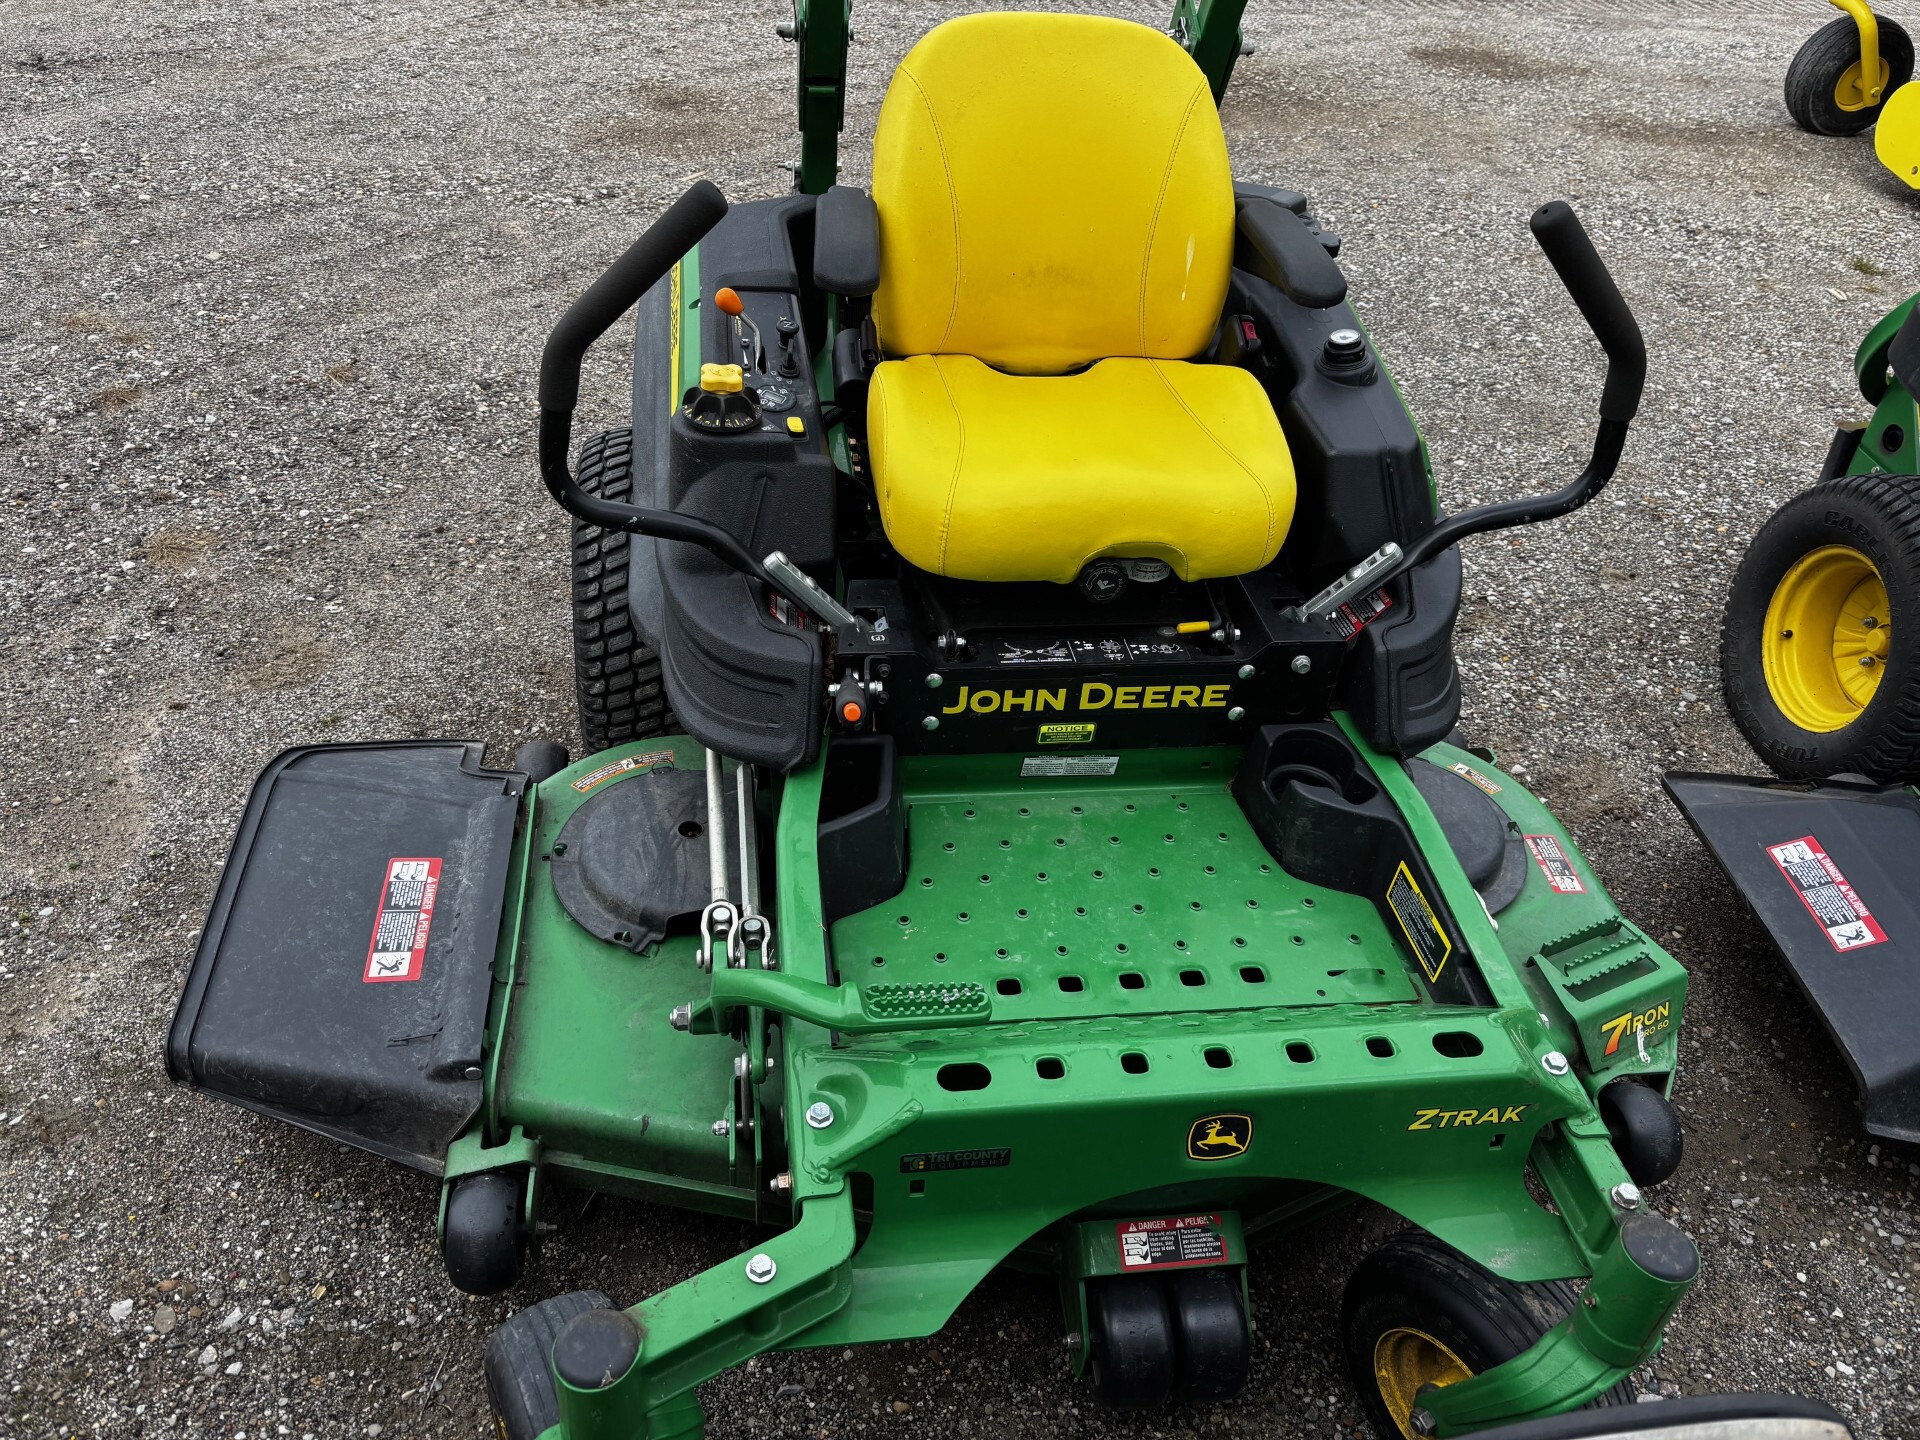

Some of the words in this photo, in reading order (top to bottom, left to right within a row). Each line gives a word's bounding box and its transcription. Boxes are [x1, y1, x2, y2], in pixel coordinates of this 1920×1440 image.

[1823, 511, 1903, 629] CARLISLE
[1726, 617, 1766, 738] MASTER
[943, 685, 1067, 714] JOHN
[1079, 682, 1231, 709] DEERE
[1047, 724, 1088, 732] NOTICE
[1760, 735, 1819, 764] TURF
[421, 884, 437, 910] DANGER
[1821, 858, 1844, 883] DANGER
[1844, 890, 1869, 917] PELIGRO
[414, 920, 429, 949] PELIGRO
[1657, 1019, 1669, 1030] 60
[1407, 1105, 1528, 1131] ZTRAK
[929, 1152, 950, 1163] TRI
[954, 1150, 1009, 1161] COUNTY
[930, 1159, 1005, 1169] EQUIPMENT
[1138, 1220, 1166, 1230] DANGER
[1185, 1216, 1213, 1226] PELIGR
